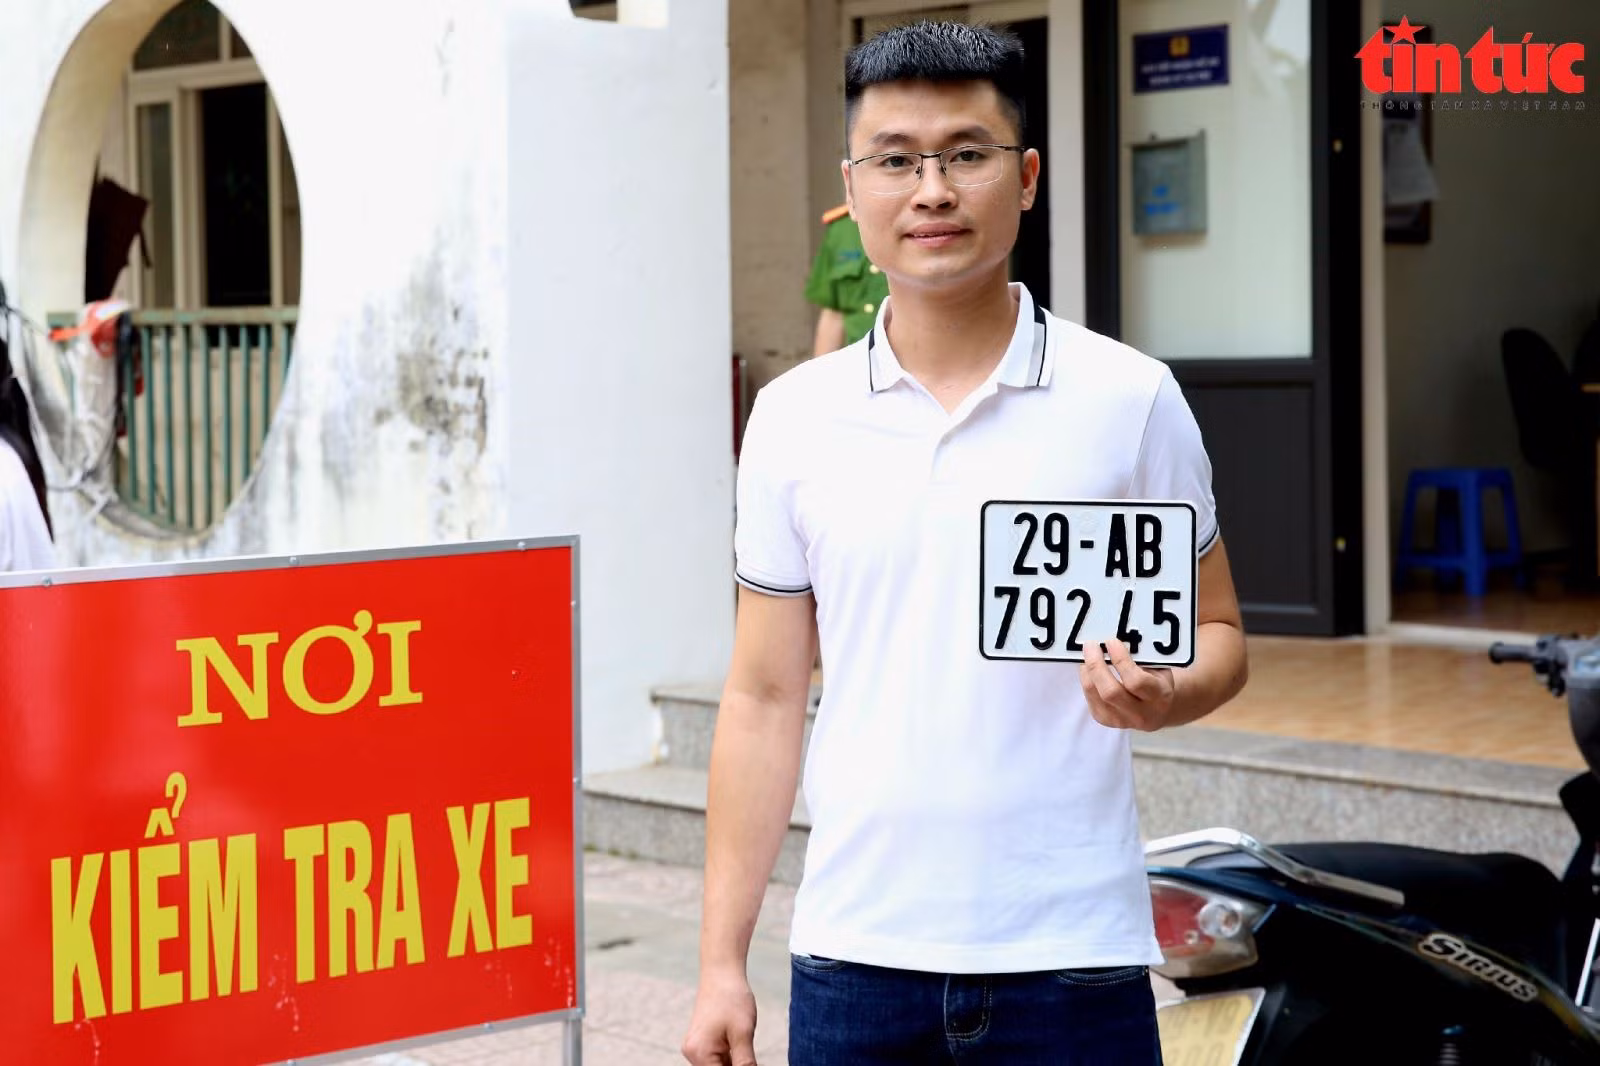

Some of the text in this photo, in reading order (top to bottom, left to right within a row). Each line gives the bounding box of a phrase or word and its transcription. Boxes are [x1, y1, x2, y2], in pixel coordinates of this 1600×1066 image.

[1012, 511, 1163, 579] 29-AB
[175, 609, 424, 728] NƠI
[50, 771, 534, 1025] KIỂM TRA XE
